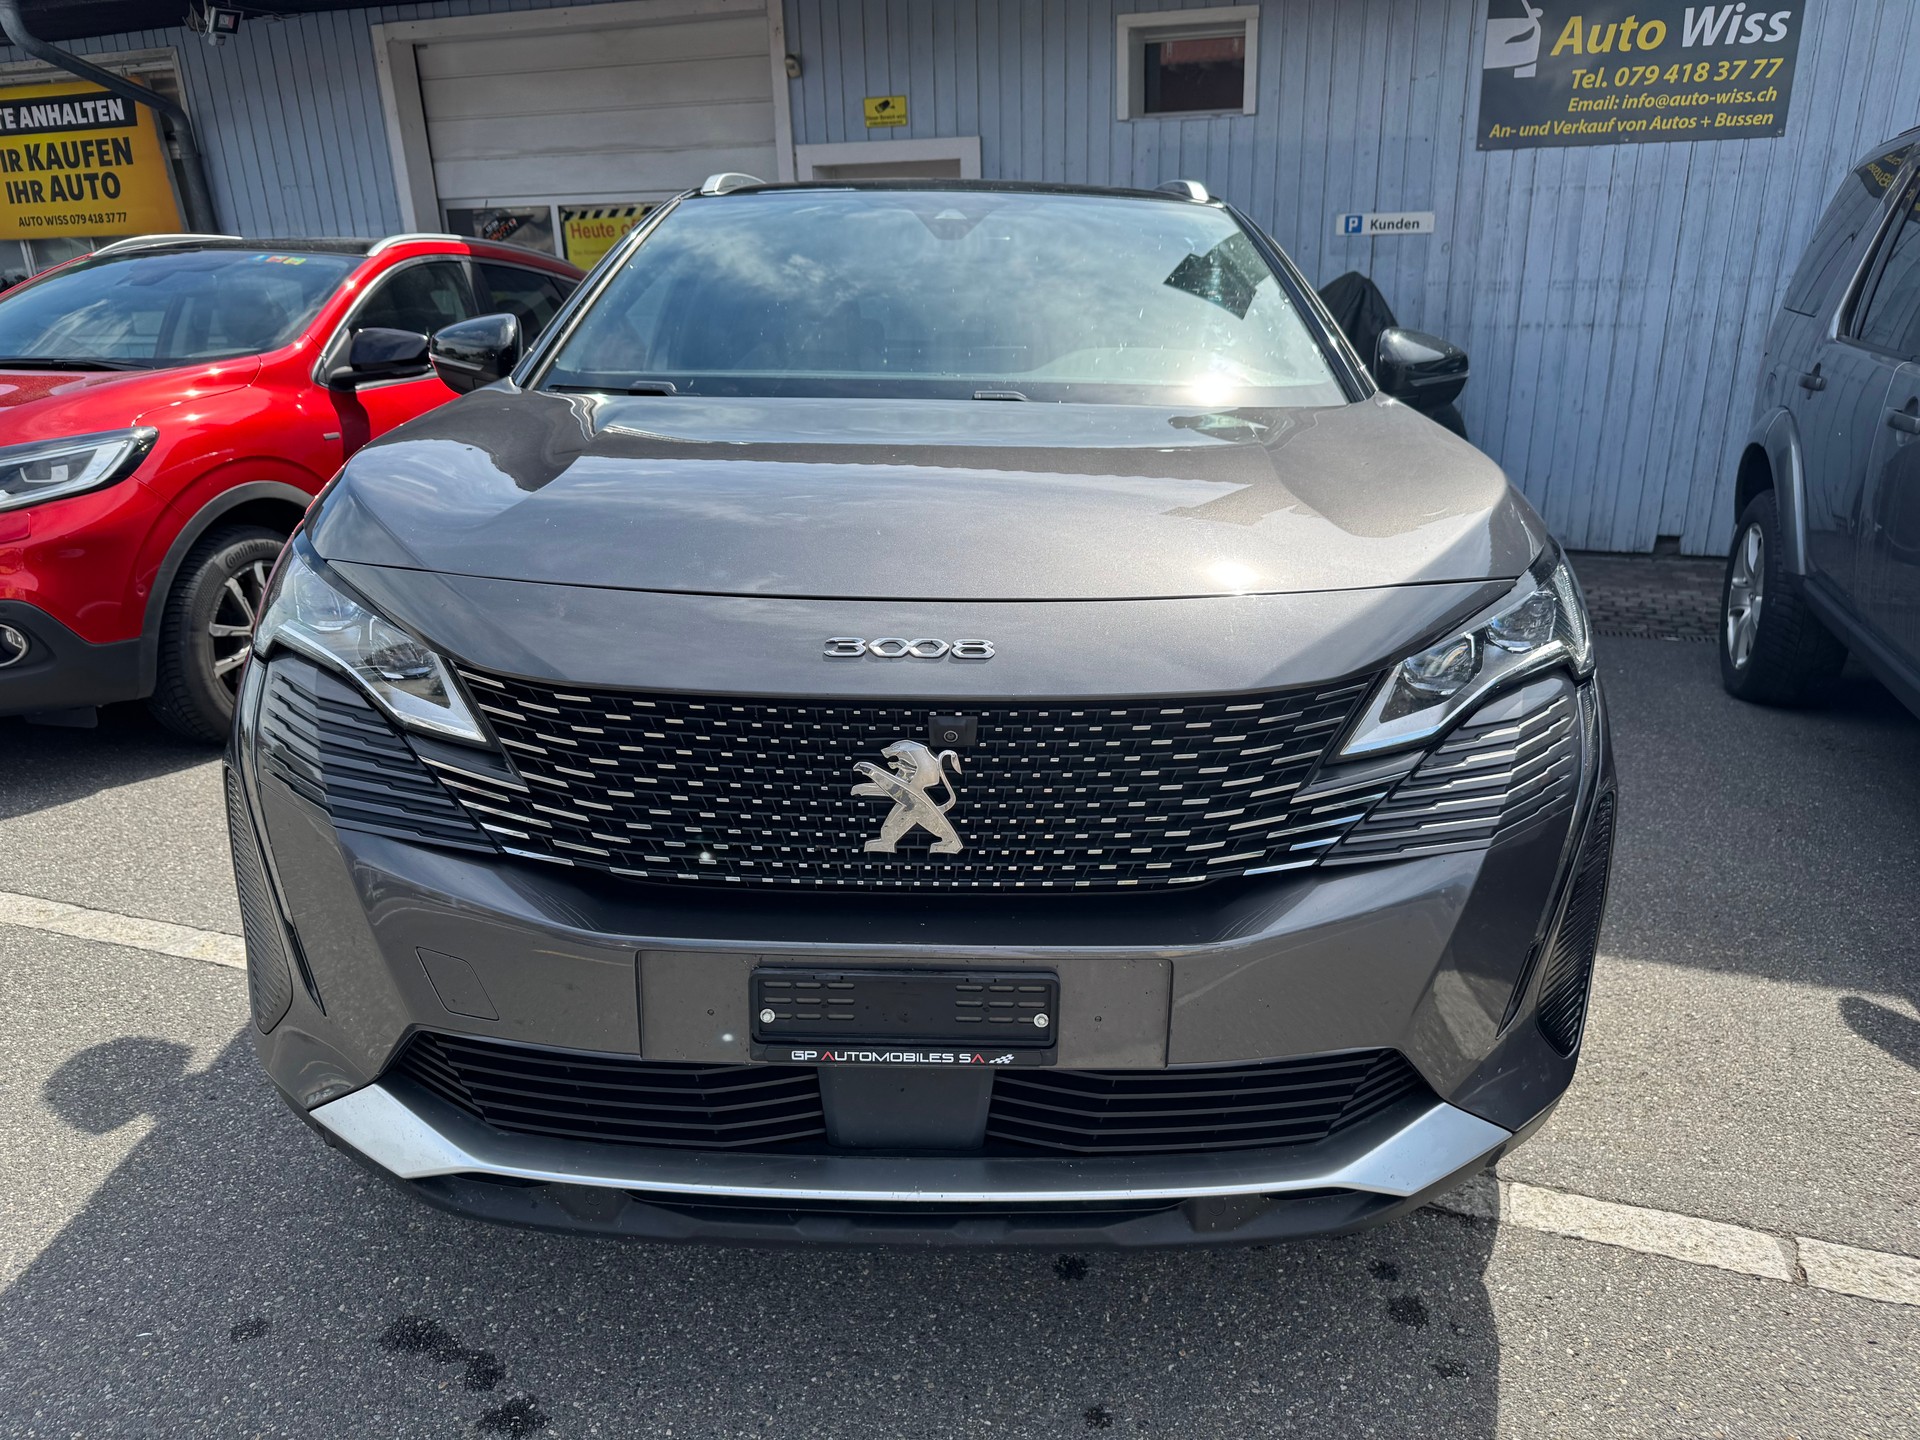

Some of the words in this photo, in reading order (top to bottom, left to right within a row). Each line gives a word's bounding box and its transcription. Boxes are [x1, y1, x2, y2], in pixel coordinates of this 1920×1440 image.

[1550, 15, 1667, 56] Auto
[1682, 2, 1792, 47] Wiss
[1572, 67, 1608, 89] Tel.
[1614, 65, 1660, 87] 079
[1663, 62, 1710, 83] 418
[1713, 59, 1748, 82] 37
[1749, 57, 1784, 79] 77
[1568, 94, 1620, 112] Email:
[1621, 86, 1778, 110] info@auto-wiss.ch
[20, 98, 125, 128] ANHALTEN
[1489, 123, 1517, 138] An-
[1519, 120, 1551, 136] und
[1553, 117, 1617, 135] Verkauf
[1617, 119, 1647, 132] von
[1648, 115, 1697, 131] Autos
[1700, 115, 1711, 128] +
[1714, 112, 1774, 128] Bussen
[24, 137, 134, 172] KAUFEN
[5, 180, 46, 205] IHR
[50, 171, 121, 203] AUTO
[18, 215, 43, 227] AUTO
[44, 214, 69, 226] WISS
[69, 213, 87, 225] 079
[88, 213, 104, 225] 418
[105, 212, 115, 224] 37
[115, 212, 127, 223] 77
[570, 222, 615, 239] Heute
[1348, 217, 1358, 232] P
[1370, 217, 1420, 231] Kunden
[823, 636, 996, 660] 3008
[791, 1050, 818, 1061] GP
[820, 1051, 954, 1063] AUTOMOBILES
[958, 1053, 985, 1064] SA
